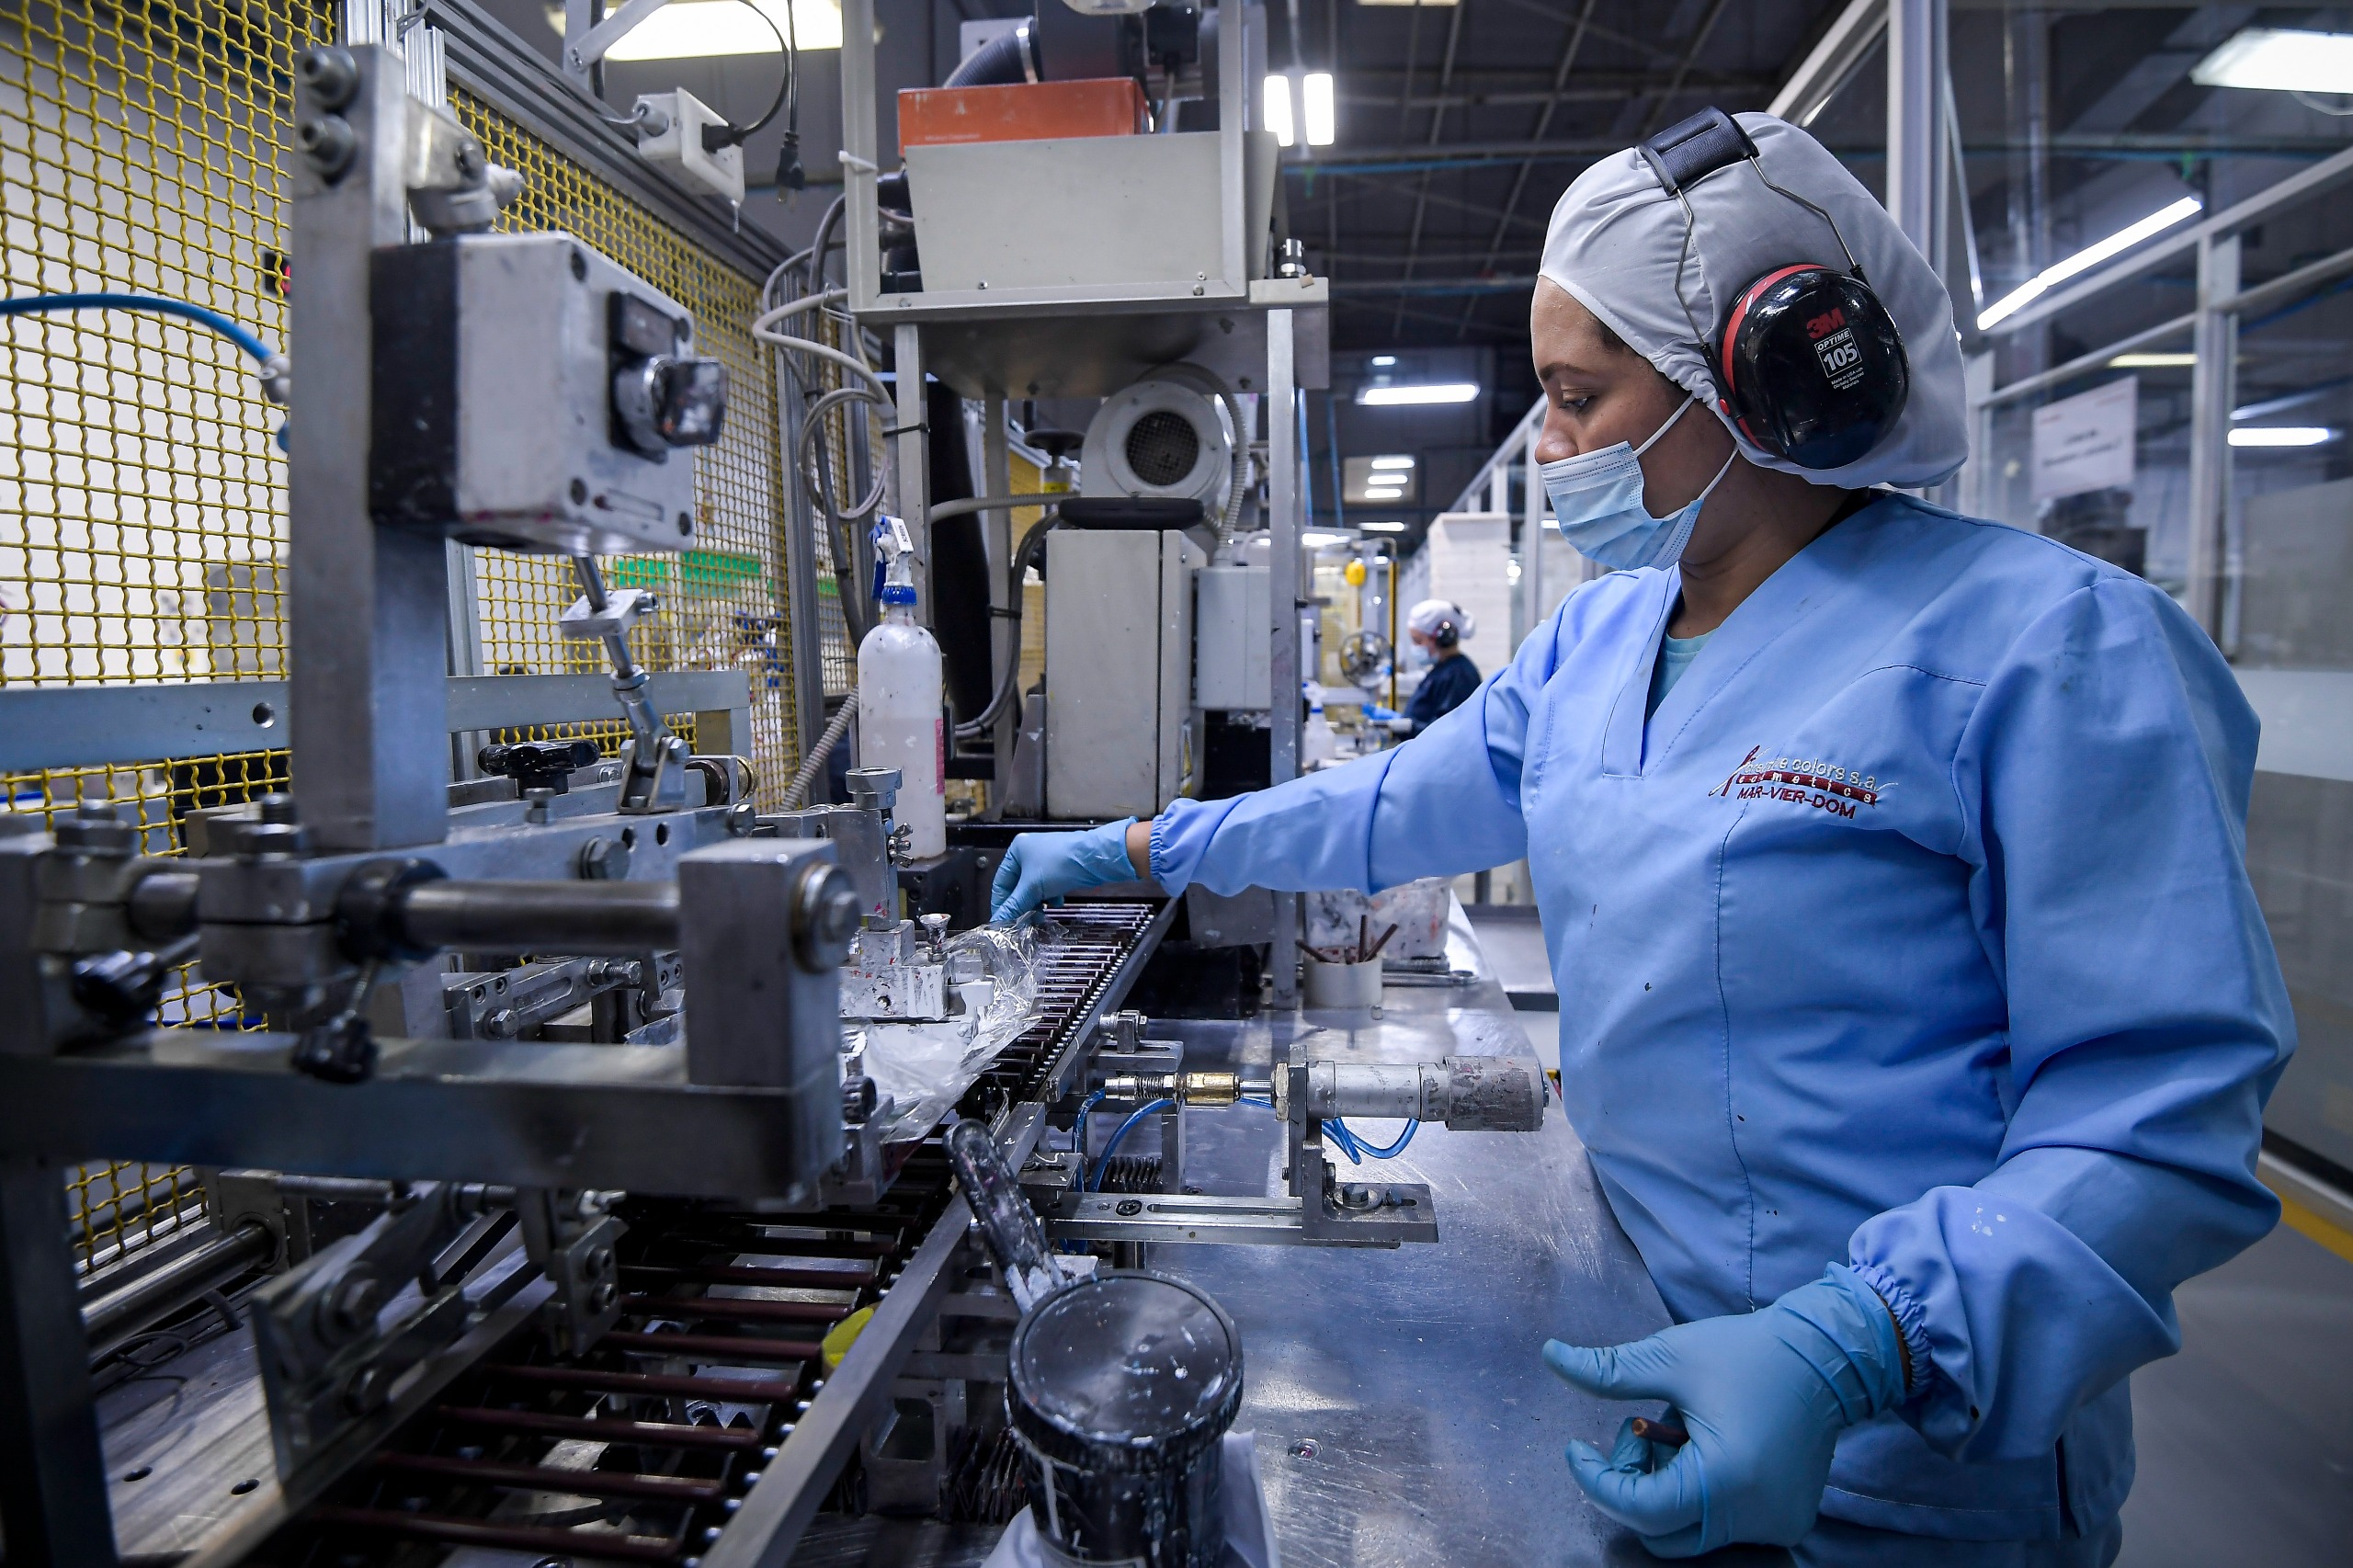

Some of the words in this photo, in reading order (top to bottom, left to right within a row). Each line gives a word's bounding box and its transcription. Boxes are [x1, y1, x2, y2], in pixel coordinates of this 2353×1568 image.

[1807, 308, 1846, 339] 3M
[1817, 331, 1850, 351] OPTIME
[1824, 342, 1858, 371] 105
[1792, 757, 1846, 780] colors
[1737, 785, 1857, 820] MAR-VIER-DOM
